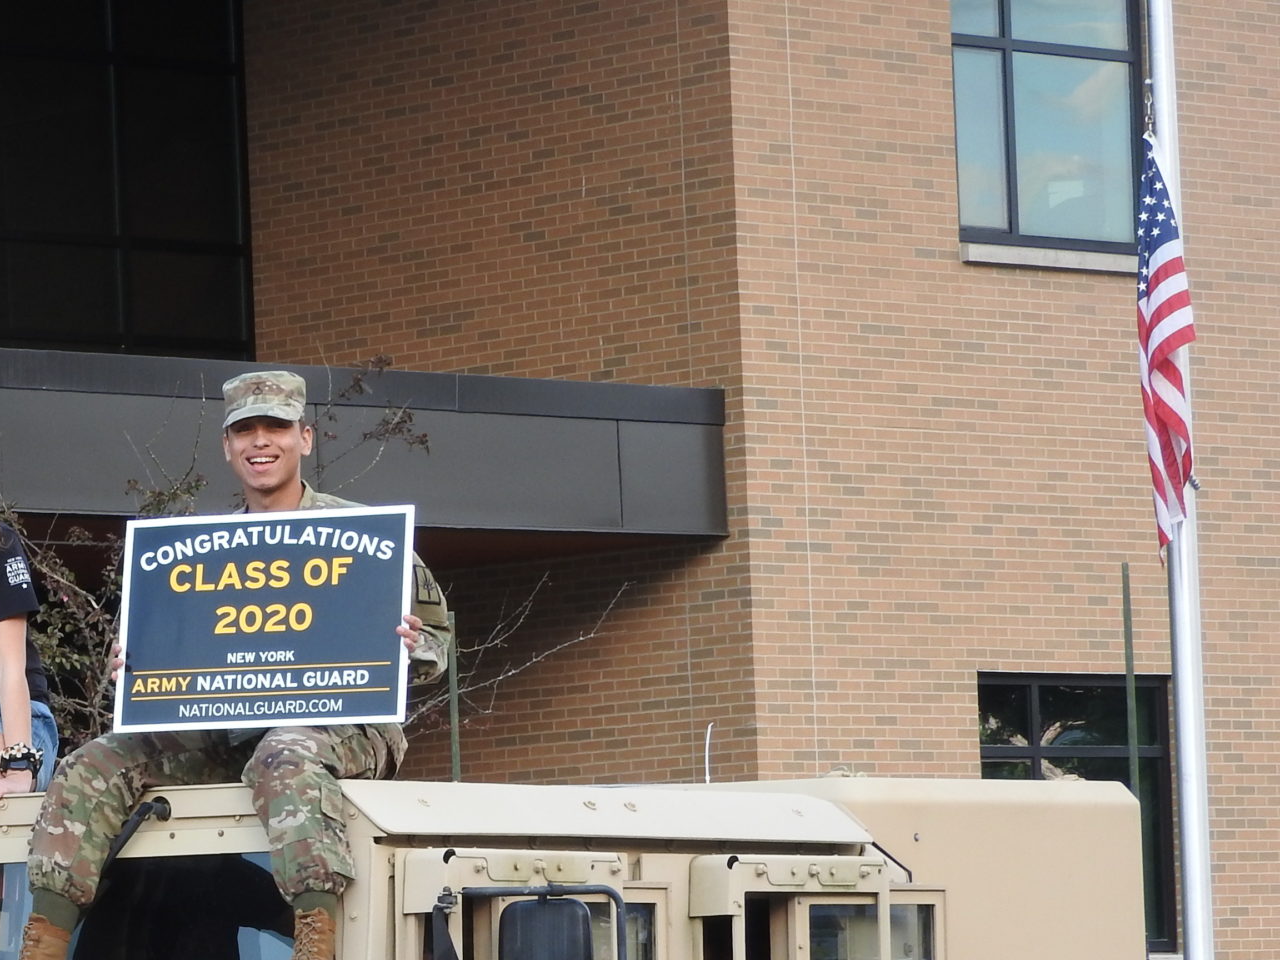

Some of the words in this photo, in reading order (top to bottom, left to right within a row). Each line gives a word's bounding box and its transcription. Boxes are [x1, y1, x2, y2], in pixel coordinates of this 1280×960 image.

[140, 525, 395, 571] CONGRATULATIONS
[169, 559, 291, 592] CLASS
[303, 556, 353, 586] OF
[214, 602, 313, 634] 2020
[227, 652, 255, 663] NEW
[259, 650, 295, 662] YORK
[131, 676, 192, 693] ARMY
[196, 672, 297, 691] NATIONAL
[302, 669, 369, 687] GUARD
[178, 699, 343, 717] NATIONALGUARD.COM
